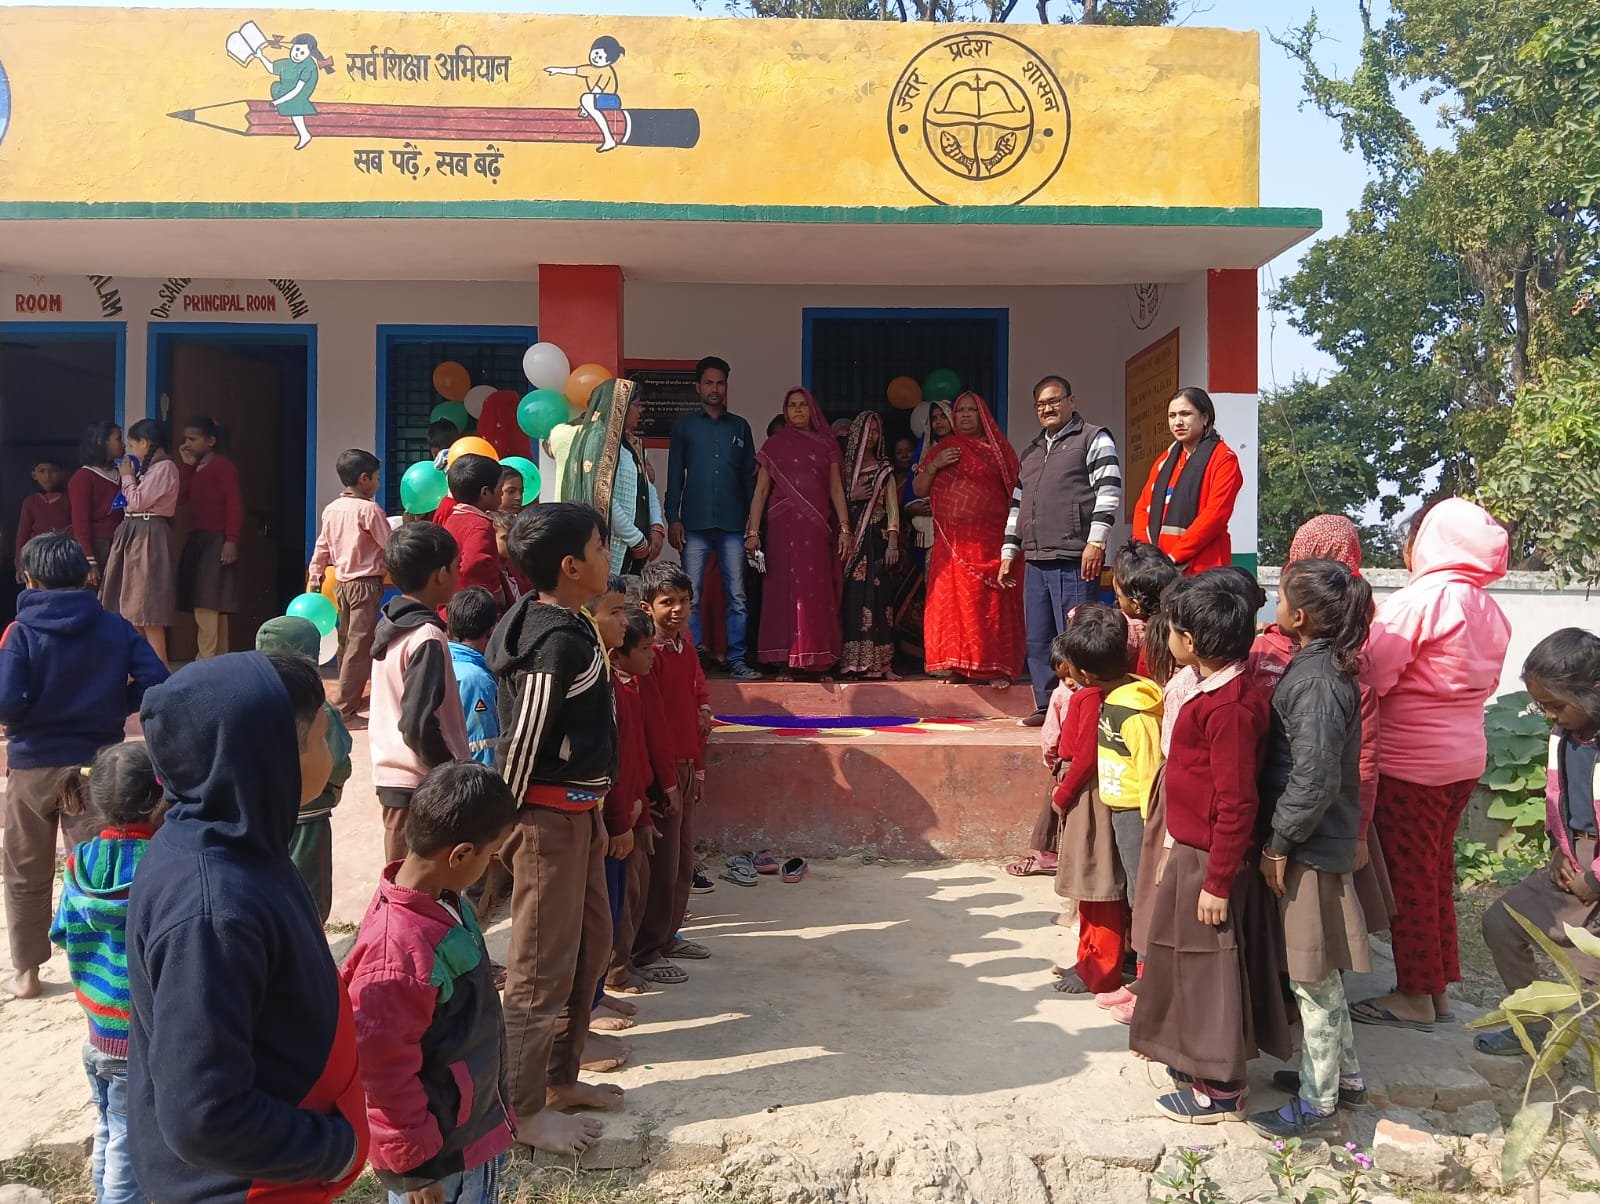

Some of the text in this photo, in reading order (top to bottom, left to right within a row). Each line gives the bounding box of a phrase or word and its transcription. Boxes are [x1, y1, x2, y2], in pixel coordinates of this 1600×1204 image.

[345, 44, 513, 83] सर्व शिक्षा अभियान
[896, 67, 928, 113] उत्तर
[943, 36, 993, 62] प्रदेश
[1022, 61, 1060, 113] शासन
[353, 149, 385, 174] सब
[434, 151, 473, 177] सब
[473, 143, 505, 185] बढ़ें
[15, 293, 62, 313] ROOM
[183, 294, 276, 312] PRINCIPAL ROOM
